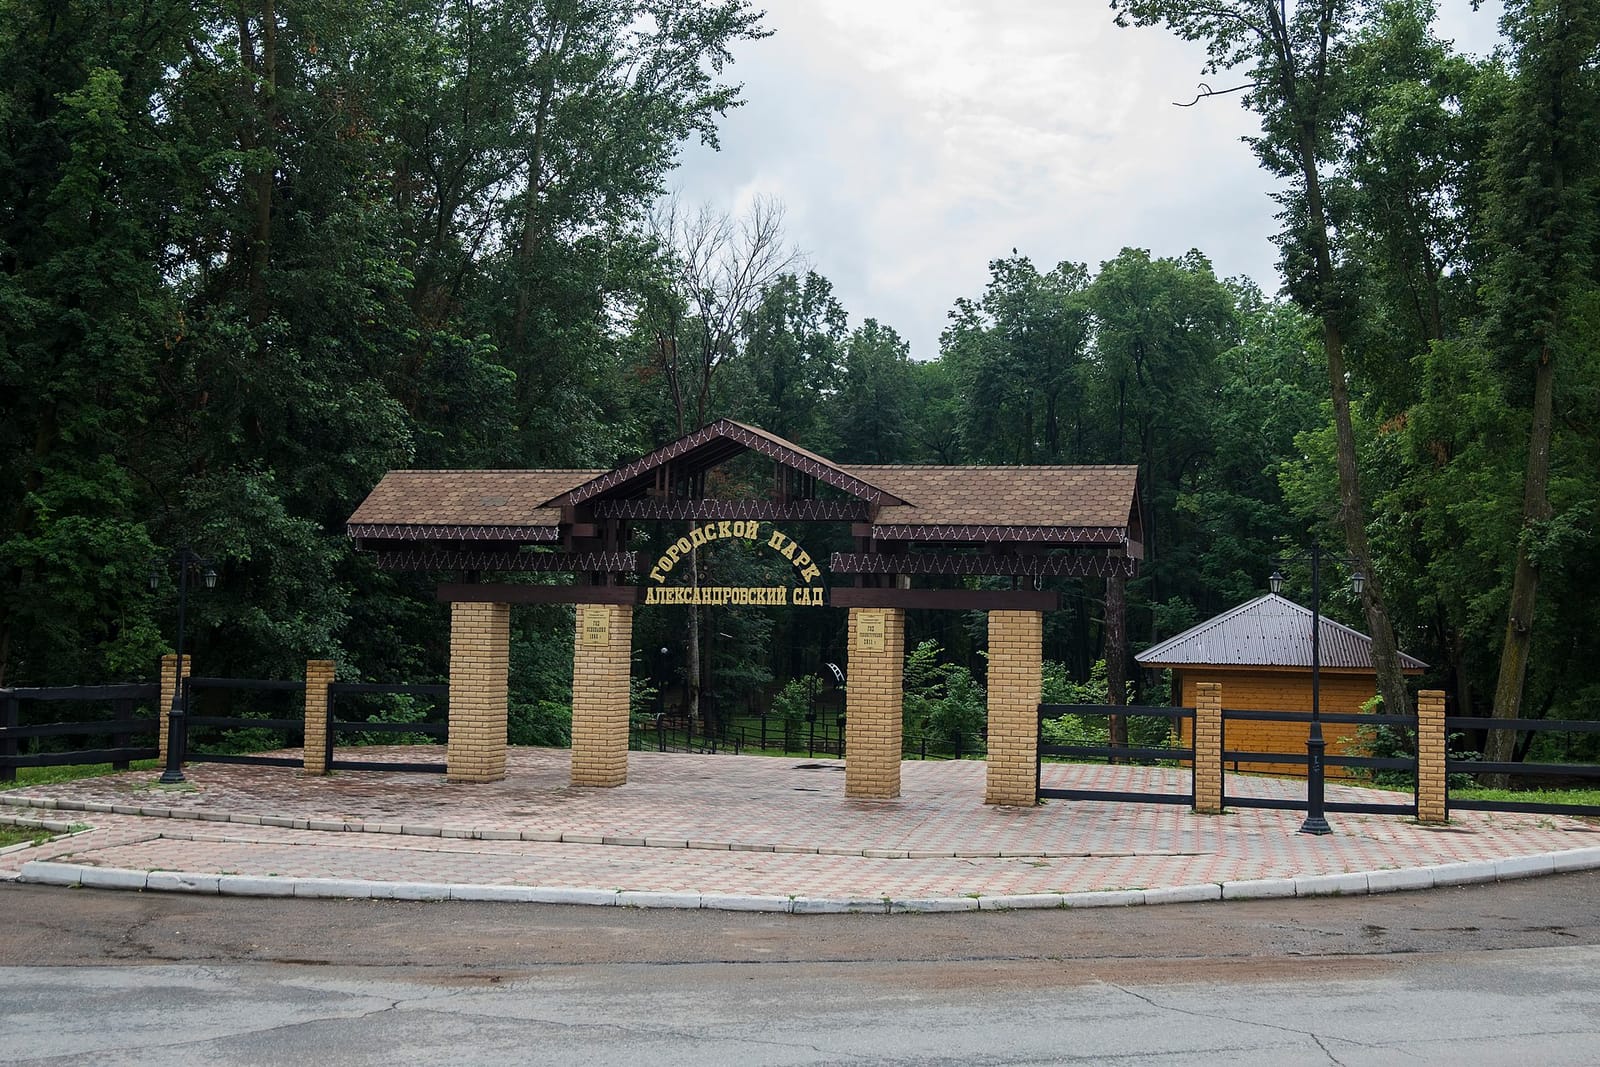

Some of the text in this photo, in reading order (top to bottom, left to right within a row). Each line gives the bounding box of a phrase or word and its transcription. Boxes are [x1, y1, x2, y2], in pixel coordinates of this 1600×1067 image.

[650, 520, 821, 583] ГОРОДСКОЙ ПАРК
[645, 585, 824, 606] АЛЕКСАНДРОВСКИЙ САД
